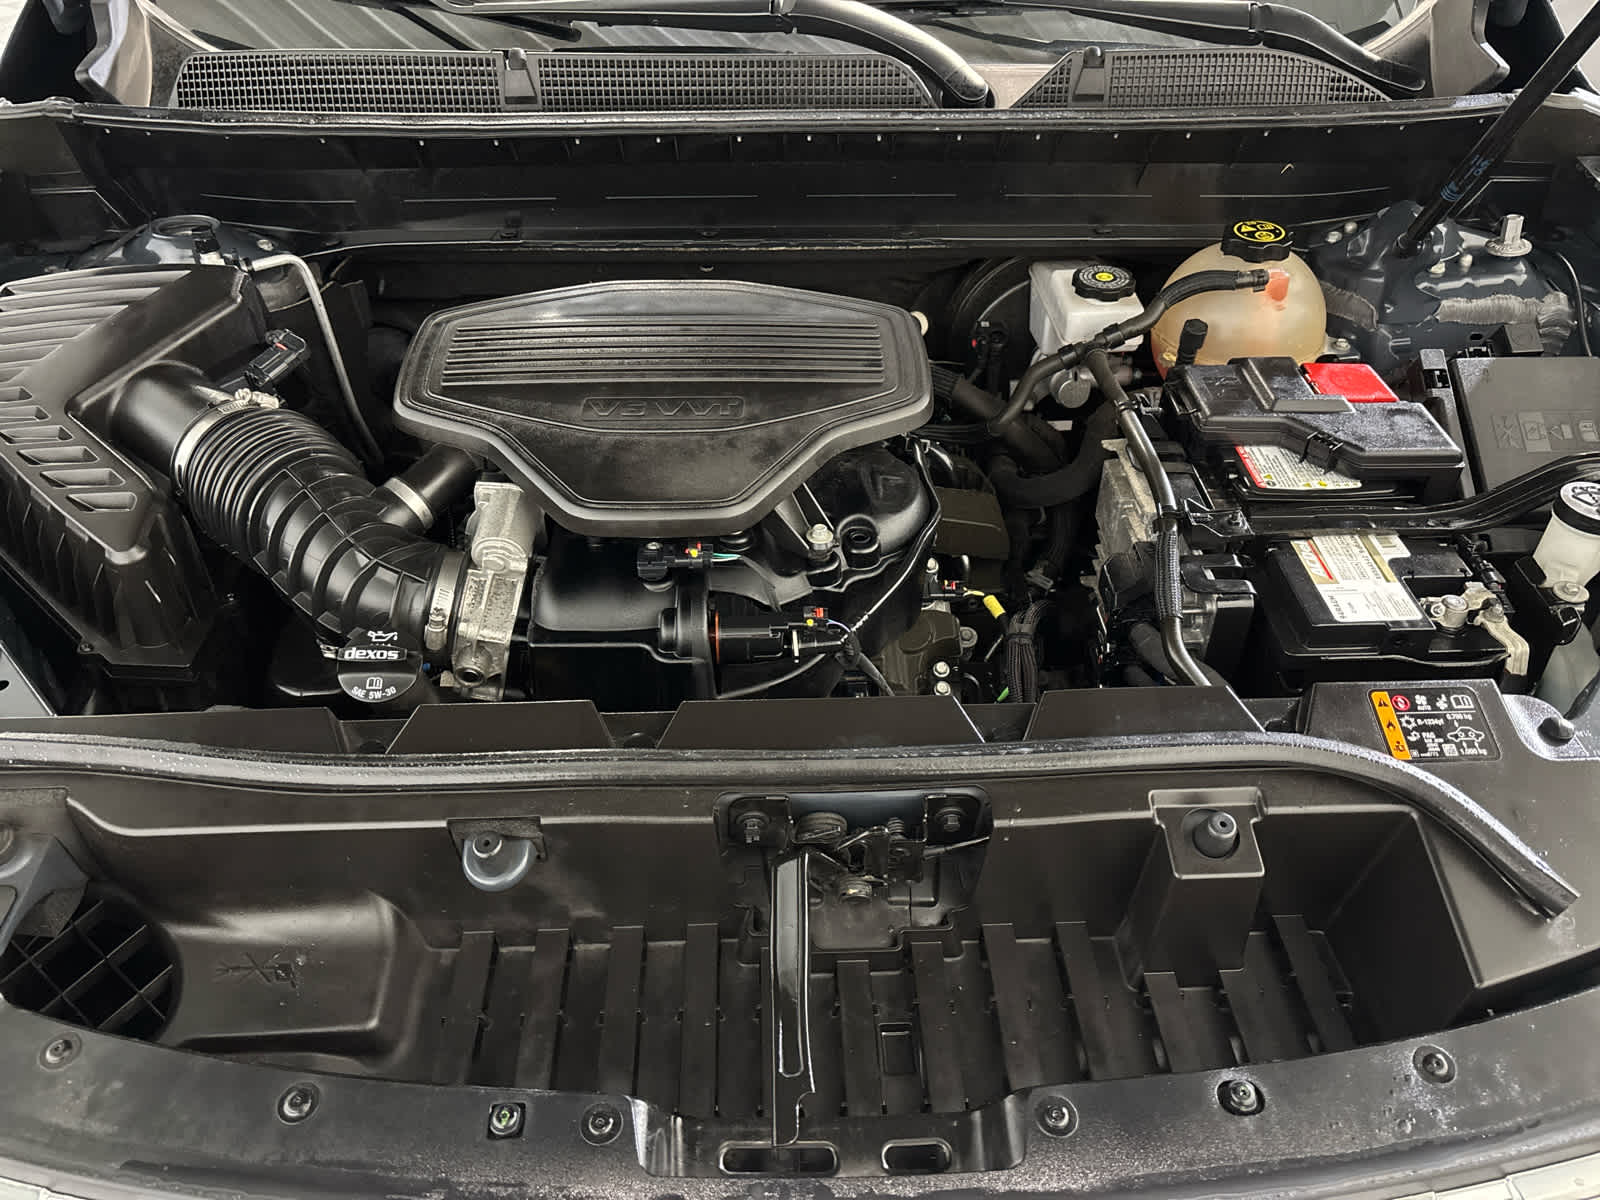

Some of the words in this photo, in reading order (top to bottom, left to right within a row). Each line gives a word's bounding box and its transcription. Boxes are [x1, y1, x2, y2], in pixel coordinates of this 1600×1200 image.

[656, 401, 739, 416] VVT
[344, 647, 399, 660] dexos
[351, 686, 367, 698] SAE
[368, 686, 397, 700] 5W-30
